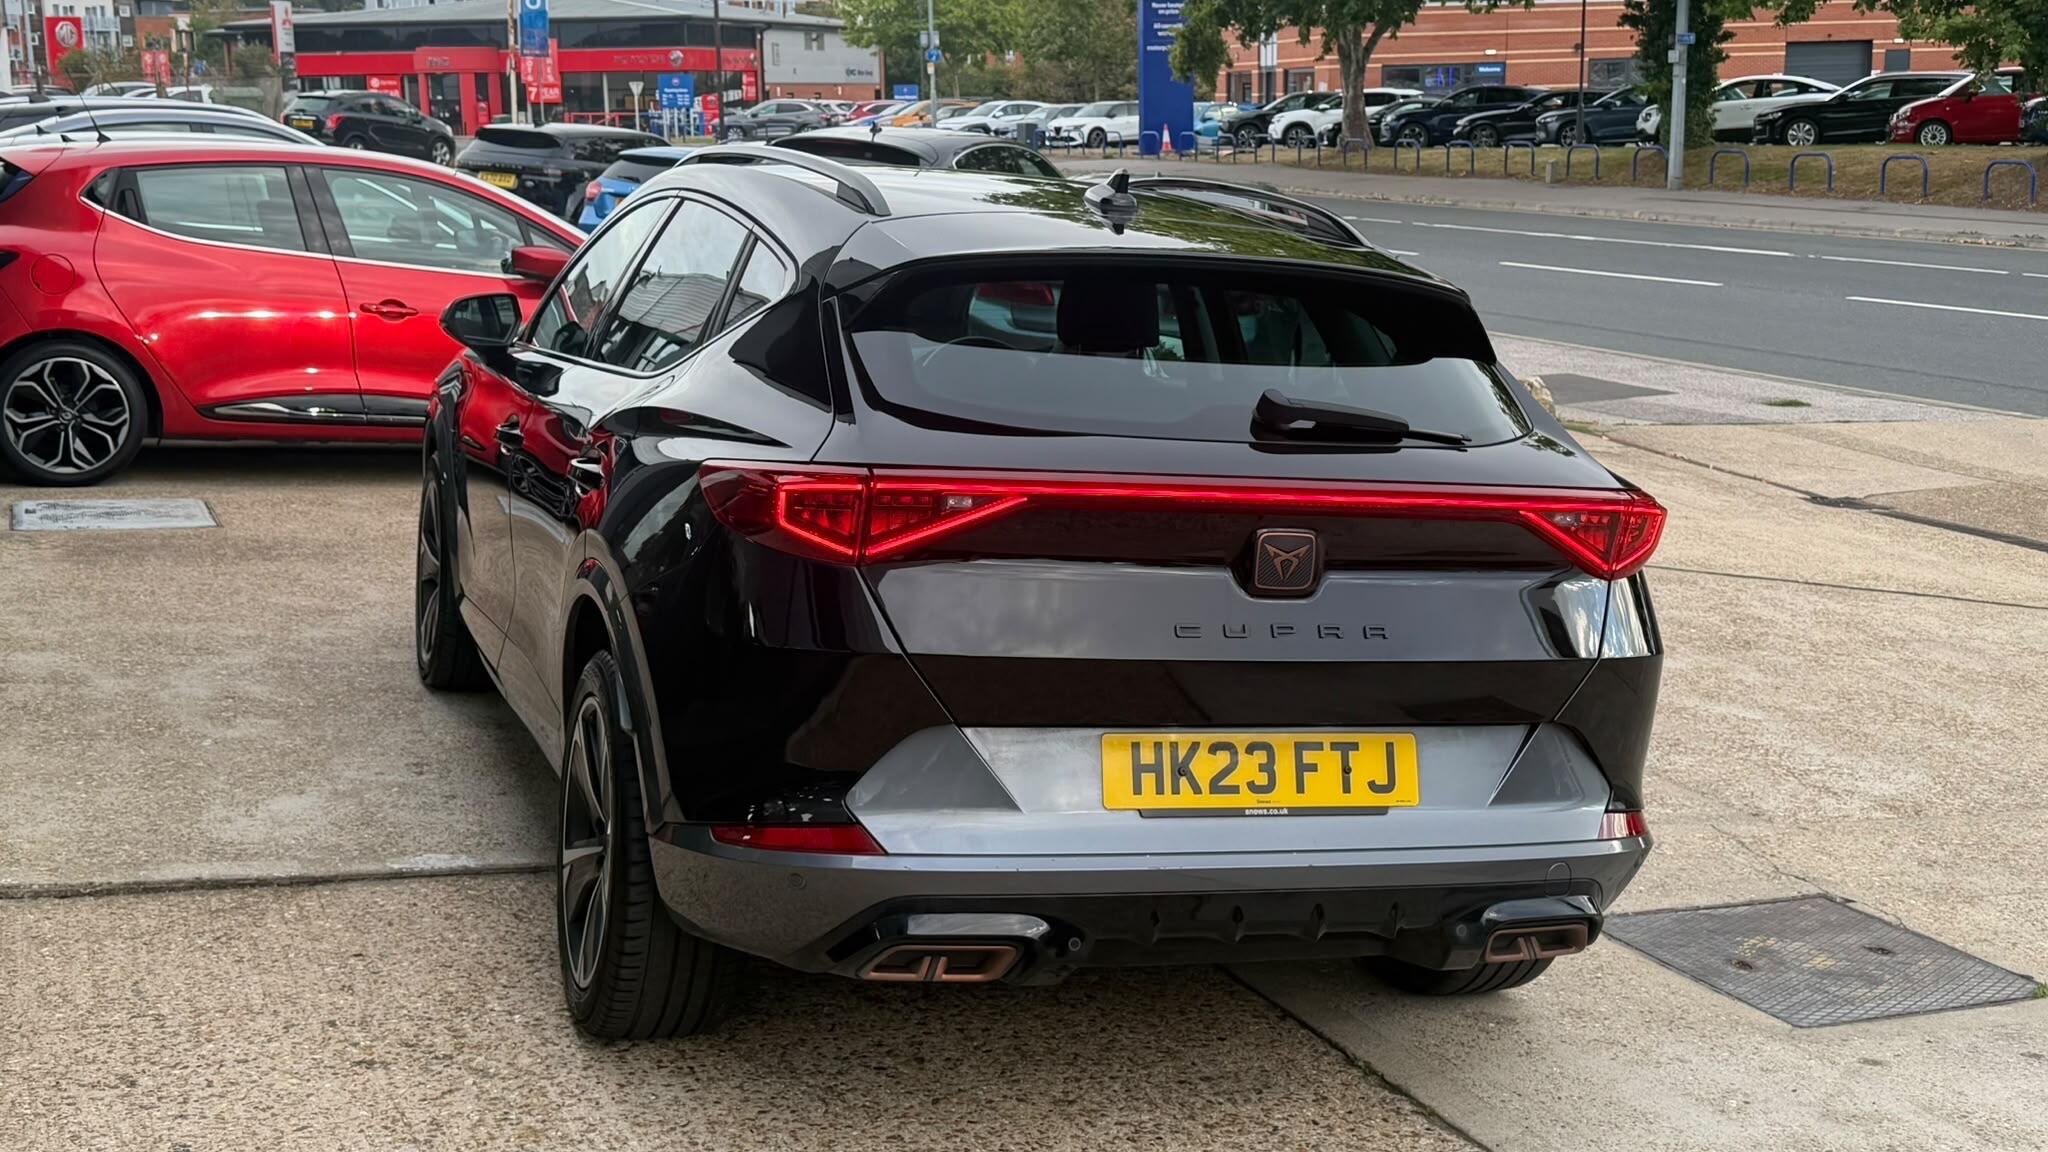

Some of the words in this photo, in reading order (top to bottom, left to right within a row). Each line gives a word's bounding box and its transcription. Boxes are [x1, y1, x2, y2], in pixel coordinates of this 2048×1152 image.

[1174, 623, 1389, 640] CUPRA
[1131, 741, 1276, 795] HK23
[1293, 741, 1396, 794] FTJ
[1244, 807, 1289, 816] snows.co.uk
